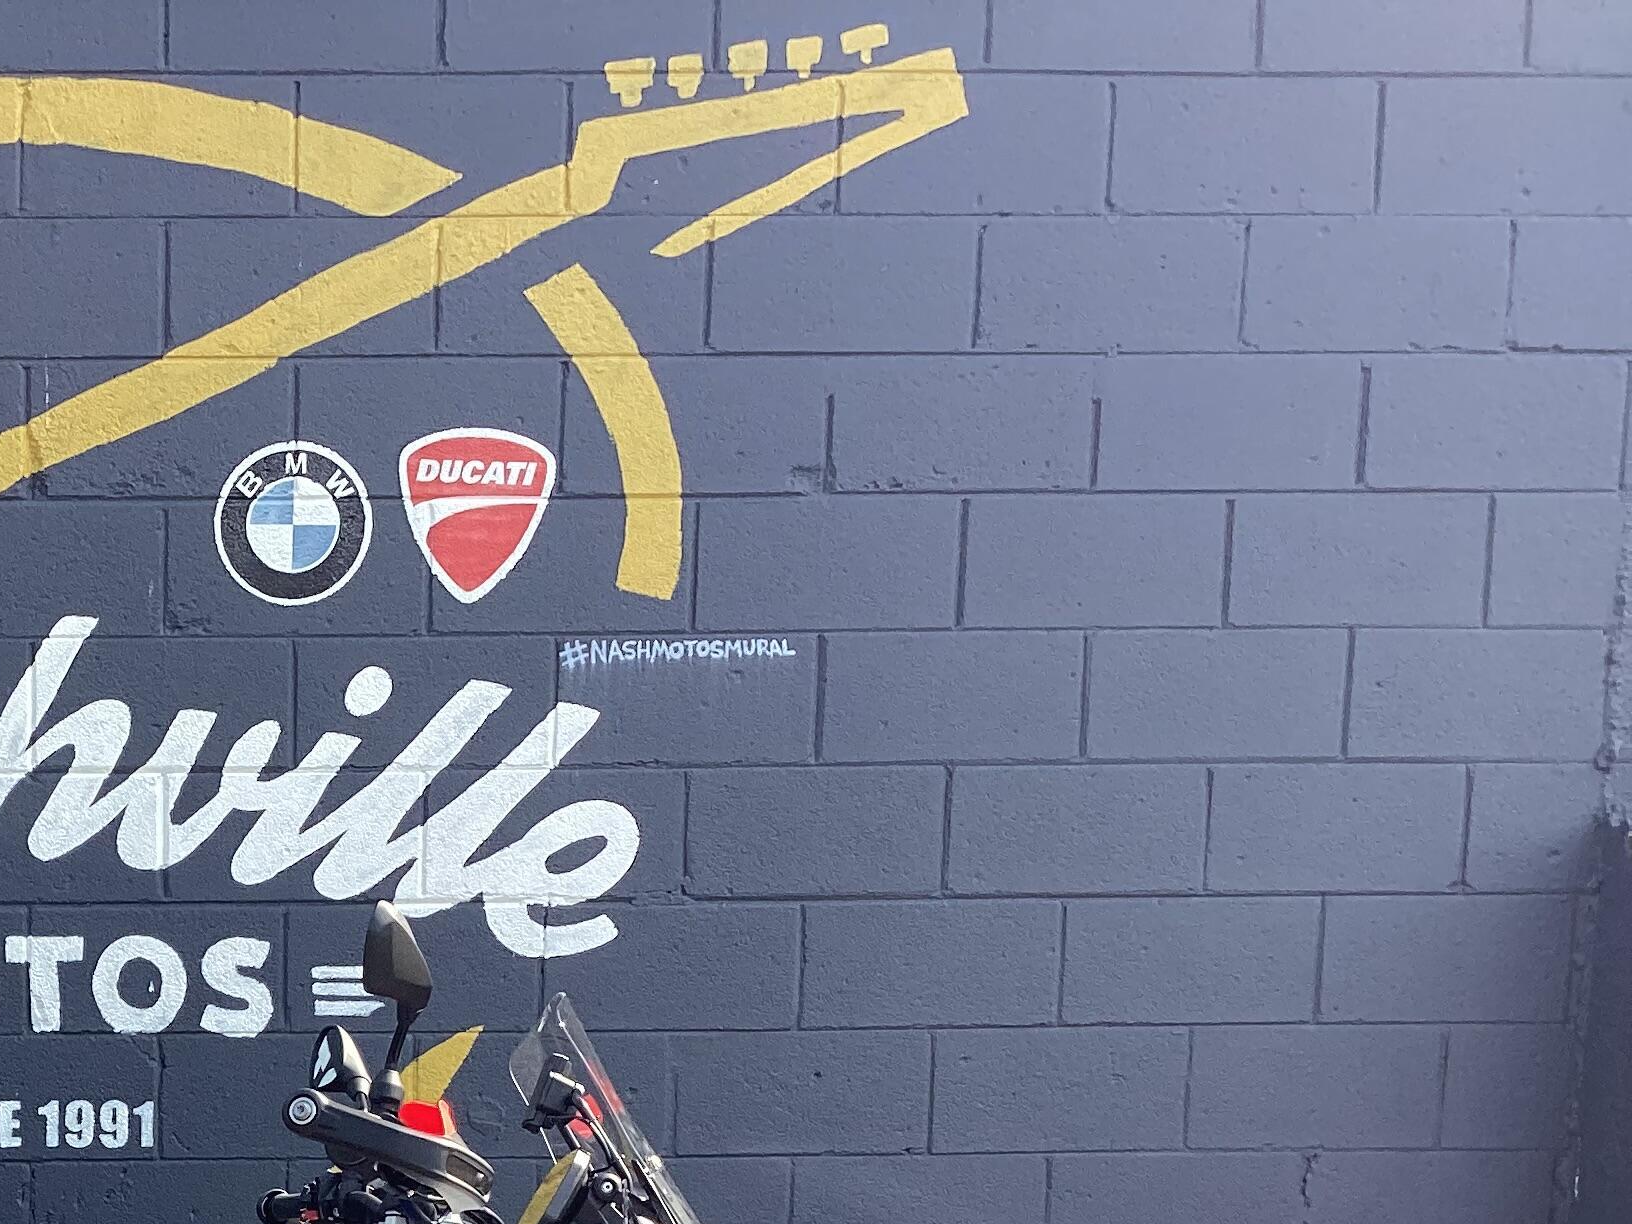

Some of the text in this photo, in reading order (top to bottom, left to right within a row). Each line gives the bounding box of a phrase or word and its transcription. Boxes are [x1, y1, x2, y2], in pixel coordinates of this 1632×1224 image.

[235, 453, 355, 499] BMW
[416, 459, 538, 486] DUCATI
[559, 638, 796, 670] #NASHMOTOSMURAL
[37, 1100, 156, 1149] 1991
